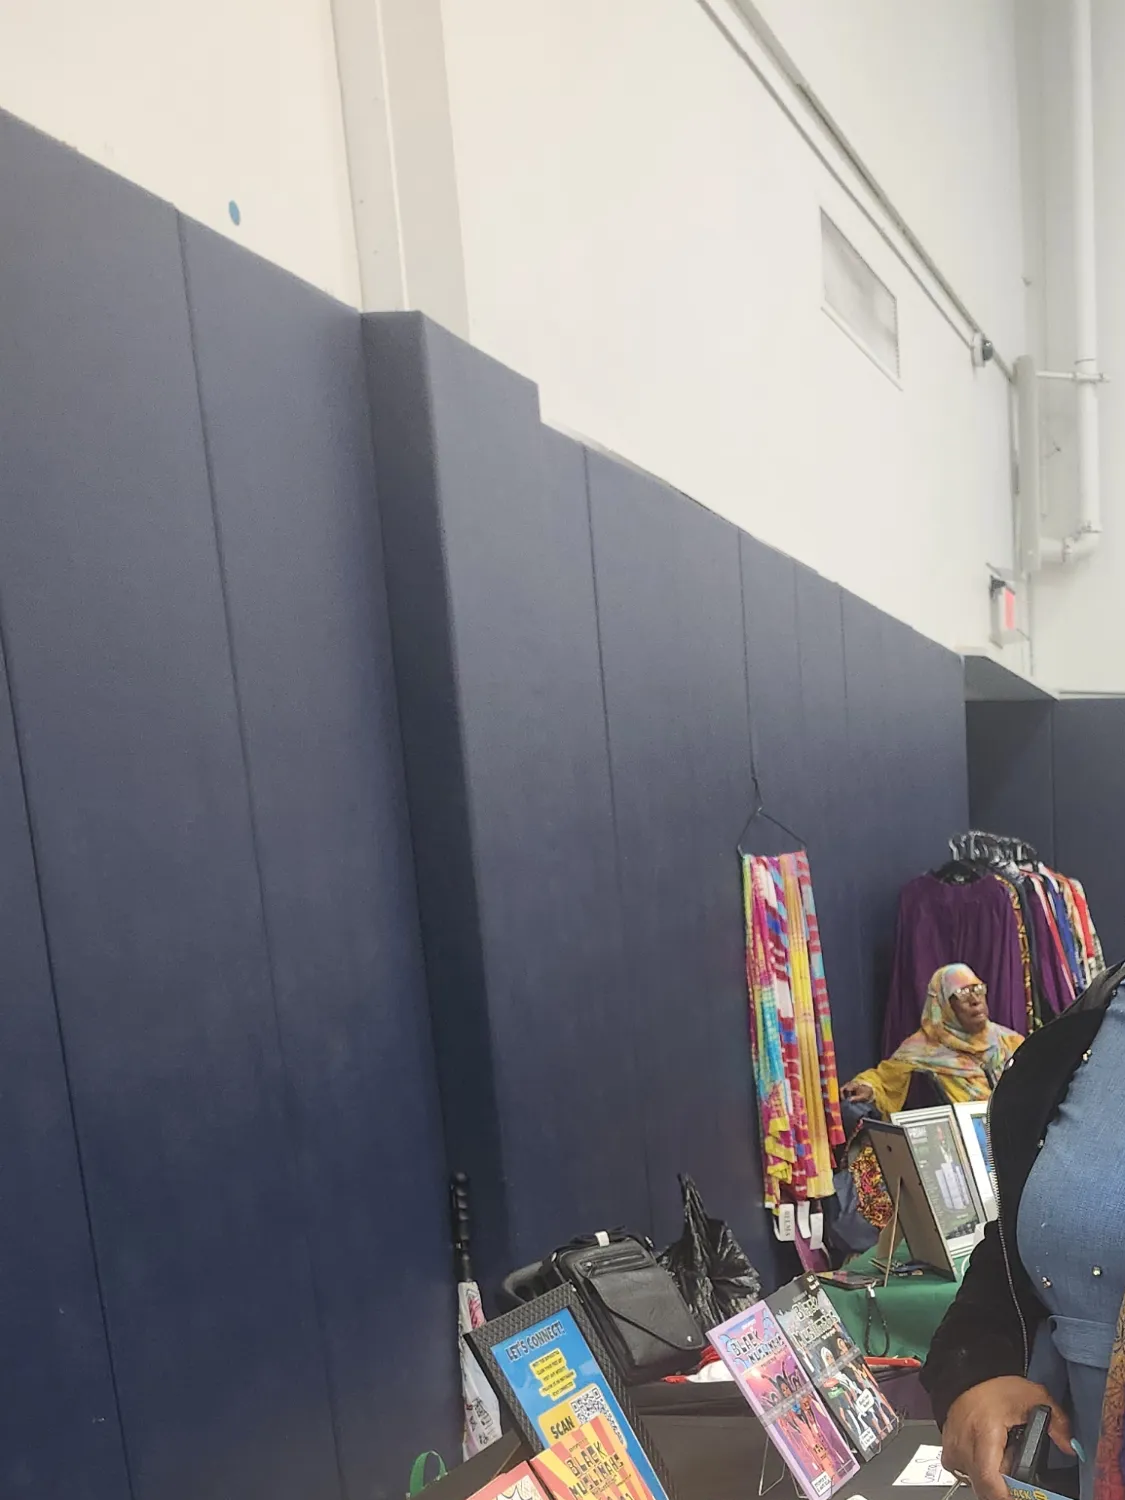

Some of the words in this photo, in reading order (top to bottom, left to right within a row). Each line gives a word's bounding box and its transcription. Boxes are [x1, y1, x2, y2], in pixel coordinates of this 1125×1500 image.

[505, 1341, 529, 1361] LET'S
[526, 1320, 566, 1349] CONNECT!
[731, 1329, 762, 1357] BLACK
[550, 1416, 576, 1439] SCAN
[565, 1441, 608, 1479] BLACK
